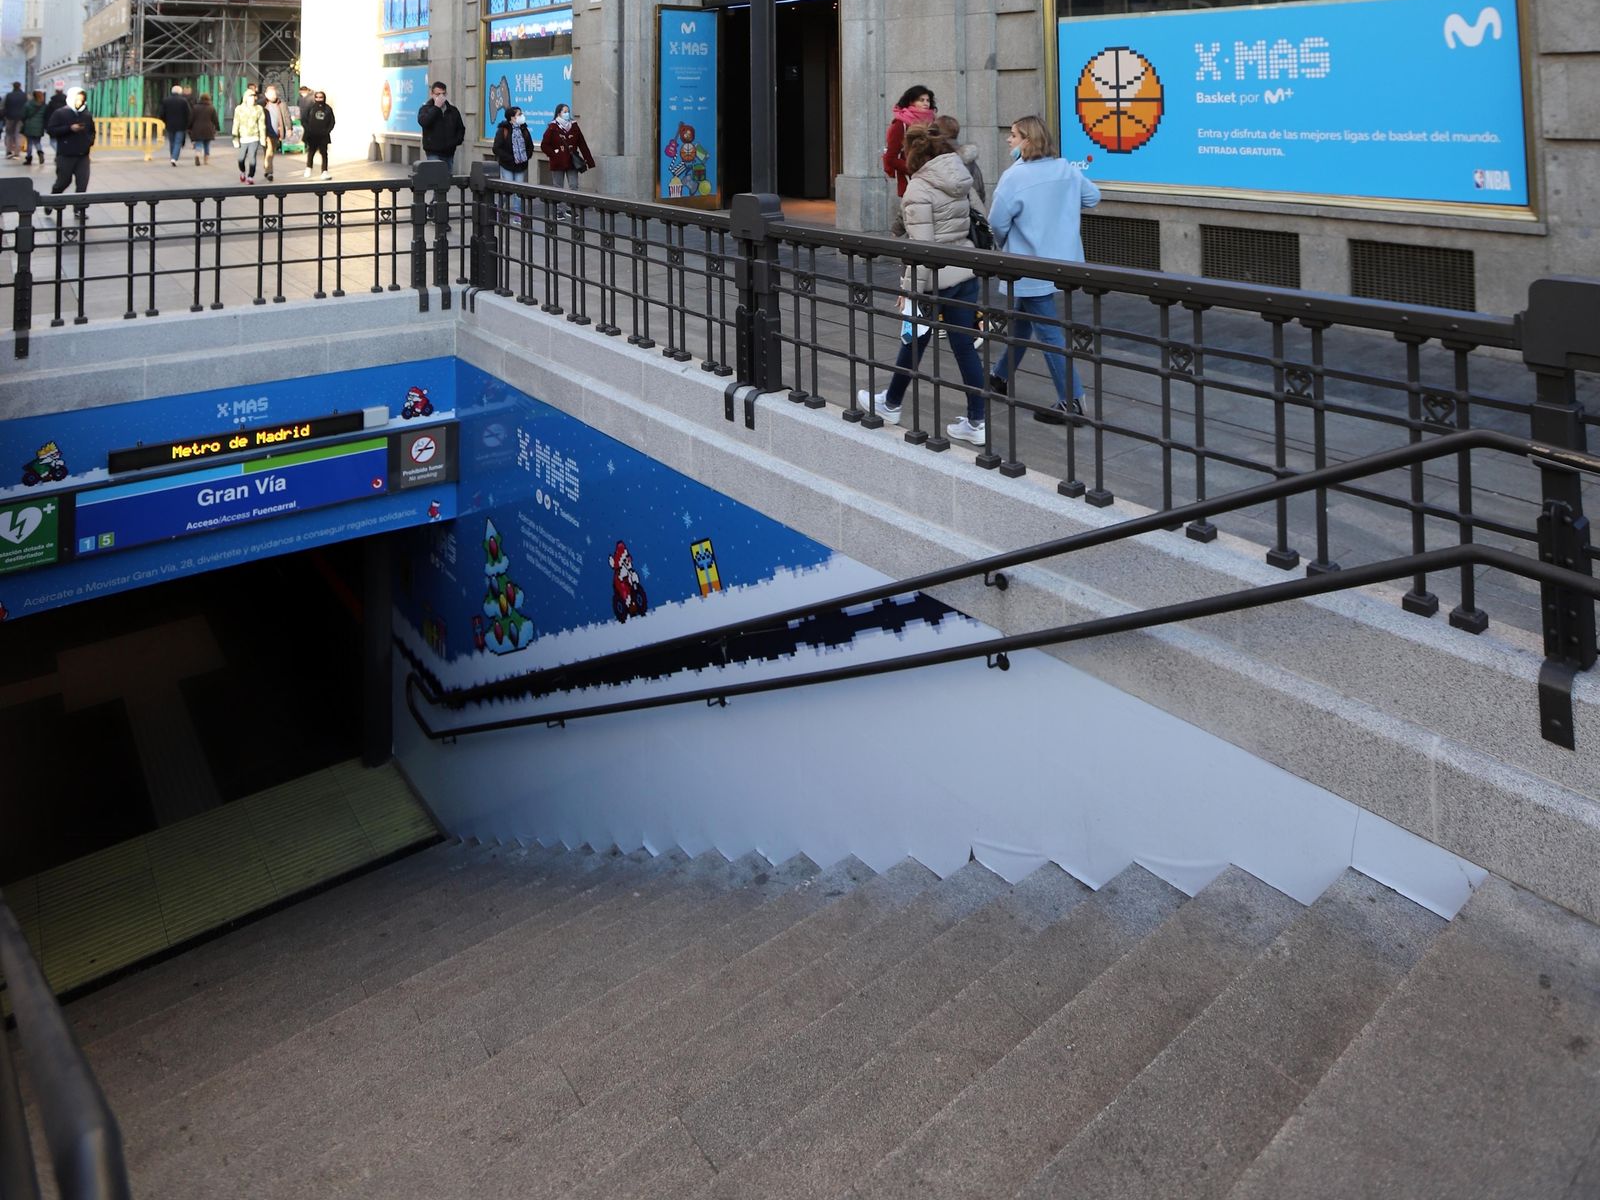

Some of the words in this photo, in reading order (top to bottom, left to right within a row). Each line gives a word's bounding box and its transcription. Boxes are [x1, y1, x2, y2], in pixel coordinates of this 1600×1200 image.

[1196, 91, 1237, 104] Basket
[1239, 93, 1260, 106] por
[1197, 128, 1222, 139] Entra
[1223, 131, 1229, 141] y
[1230, 128, 1268, 139] disfruta
[1269, 129, 1282, 140] de
[1283, 129, 1298, 140] las
[1300, 130, 1342, 143] mejores
[1344, 130, 1370, 144] ligas
[1372, 130, 1387, 142] de
[1388, 130, 1428, 142] basket
[1430, 131, 1450, 142] del
[1452, 131, 1500, 143] mundo.
[1198, 145, 1238, 155] ENTRADA
[1239, 146, 1285, 156] GRATUITA.
[172, 441, 220, 459] Metro
[229, 436, 248, 449] de
[256, 425, 311, 446] Madrid
[402, 466, 428, 477] Prohibido
[417, 472, 438, 480] smoking
[197, 485, 249, 507] Gran
[255, 474, 287, 496] Vía
[185, 509, 251, 531] Acceso/Access
[252, 500, 297, 517] Fuencarral
[102, 534, 111, 546] 5
[85, 575, 130, 597] Movistar
[132, 568, 158, 583] Gran
[303, 525, 345, 540] conseguir
[346, 516, 377, 531] regalos
